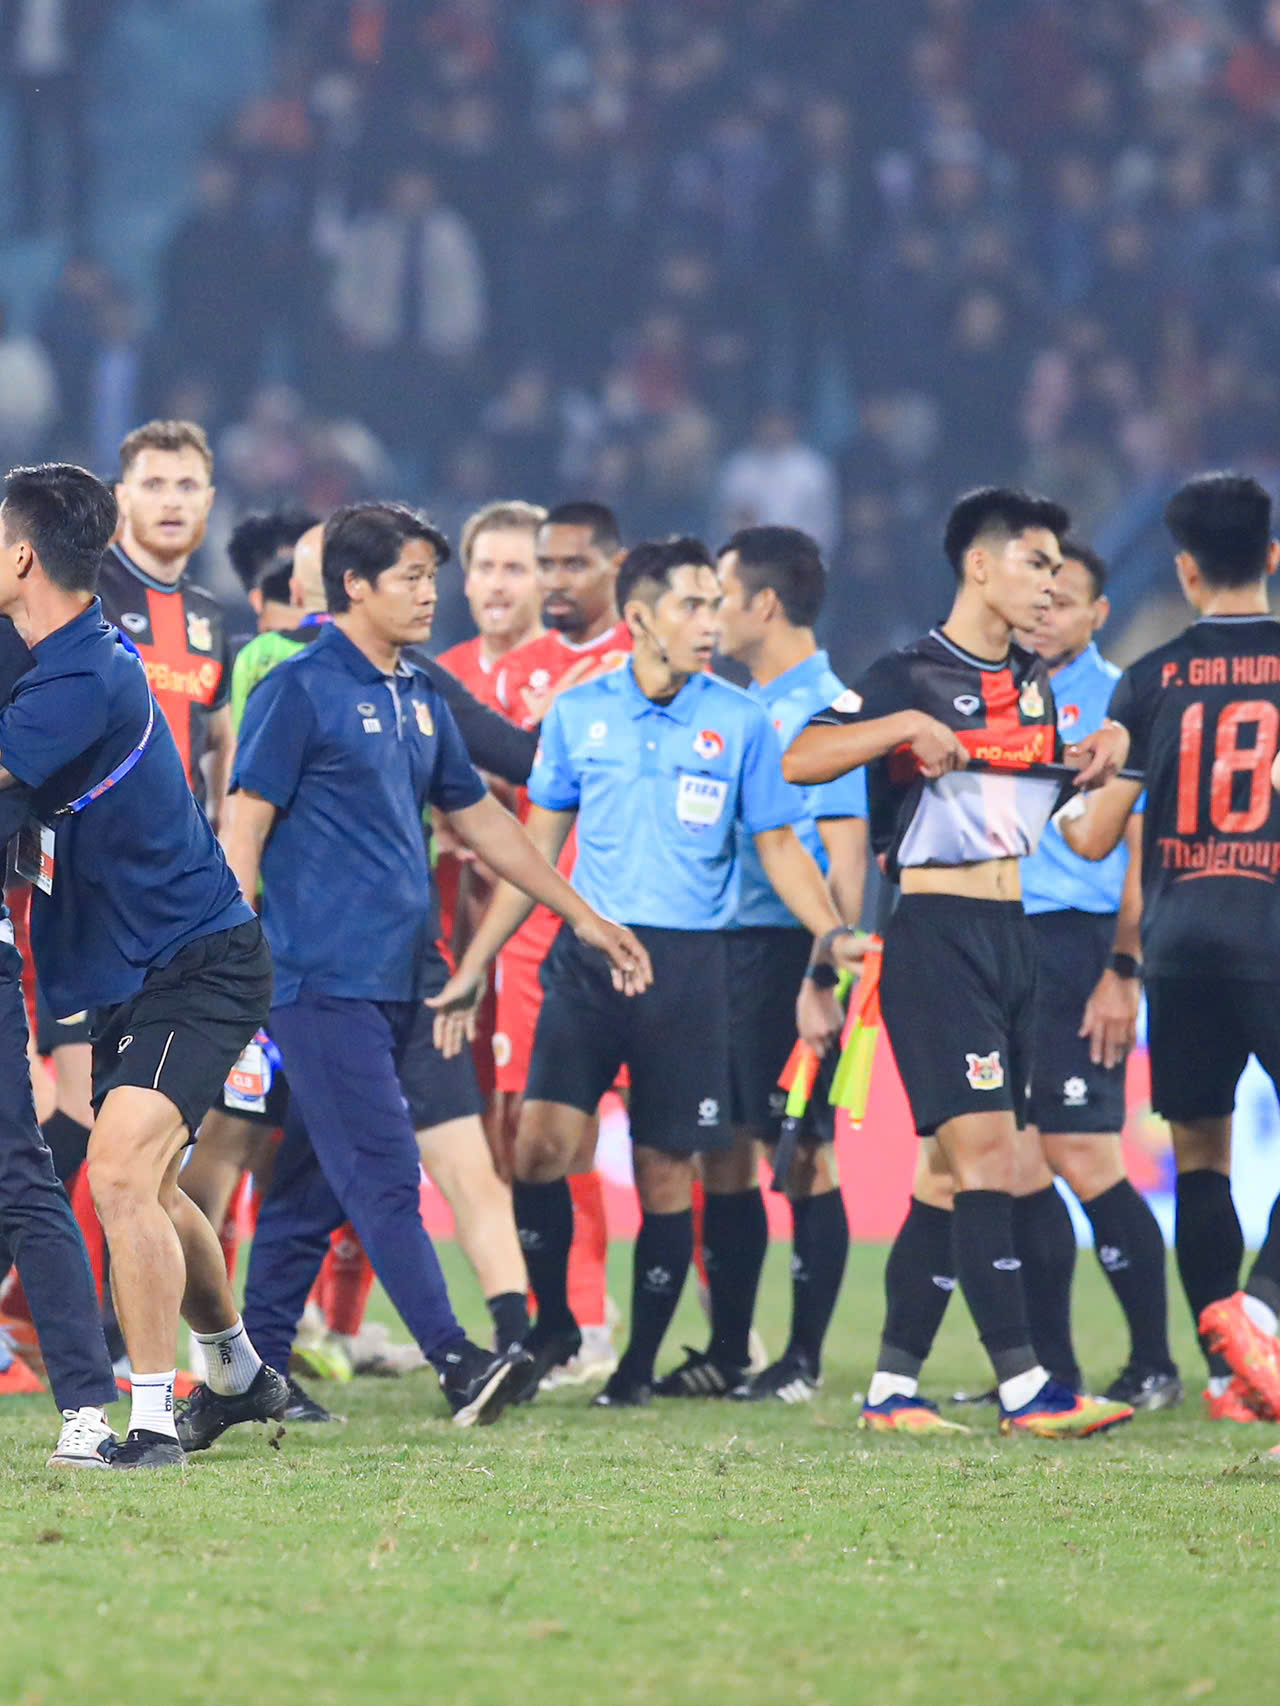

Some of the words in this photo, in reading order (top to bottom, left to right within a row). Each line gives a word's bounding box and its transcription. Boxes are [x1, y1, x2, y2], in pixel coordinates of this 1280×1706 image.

[146, 663, 203, 697] PBank
[1161, 663, 1184, 687] P.
[1188, 658, 1227, 686] GIA
[1232, 655, 1280, 685] HUN
[1176, 700, 1280, 835] 18
[685, 781, 719, 798] FIFA
